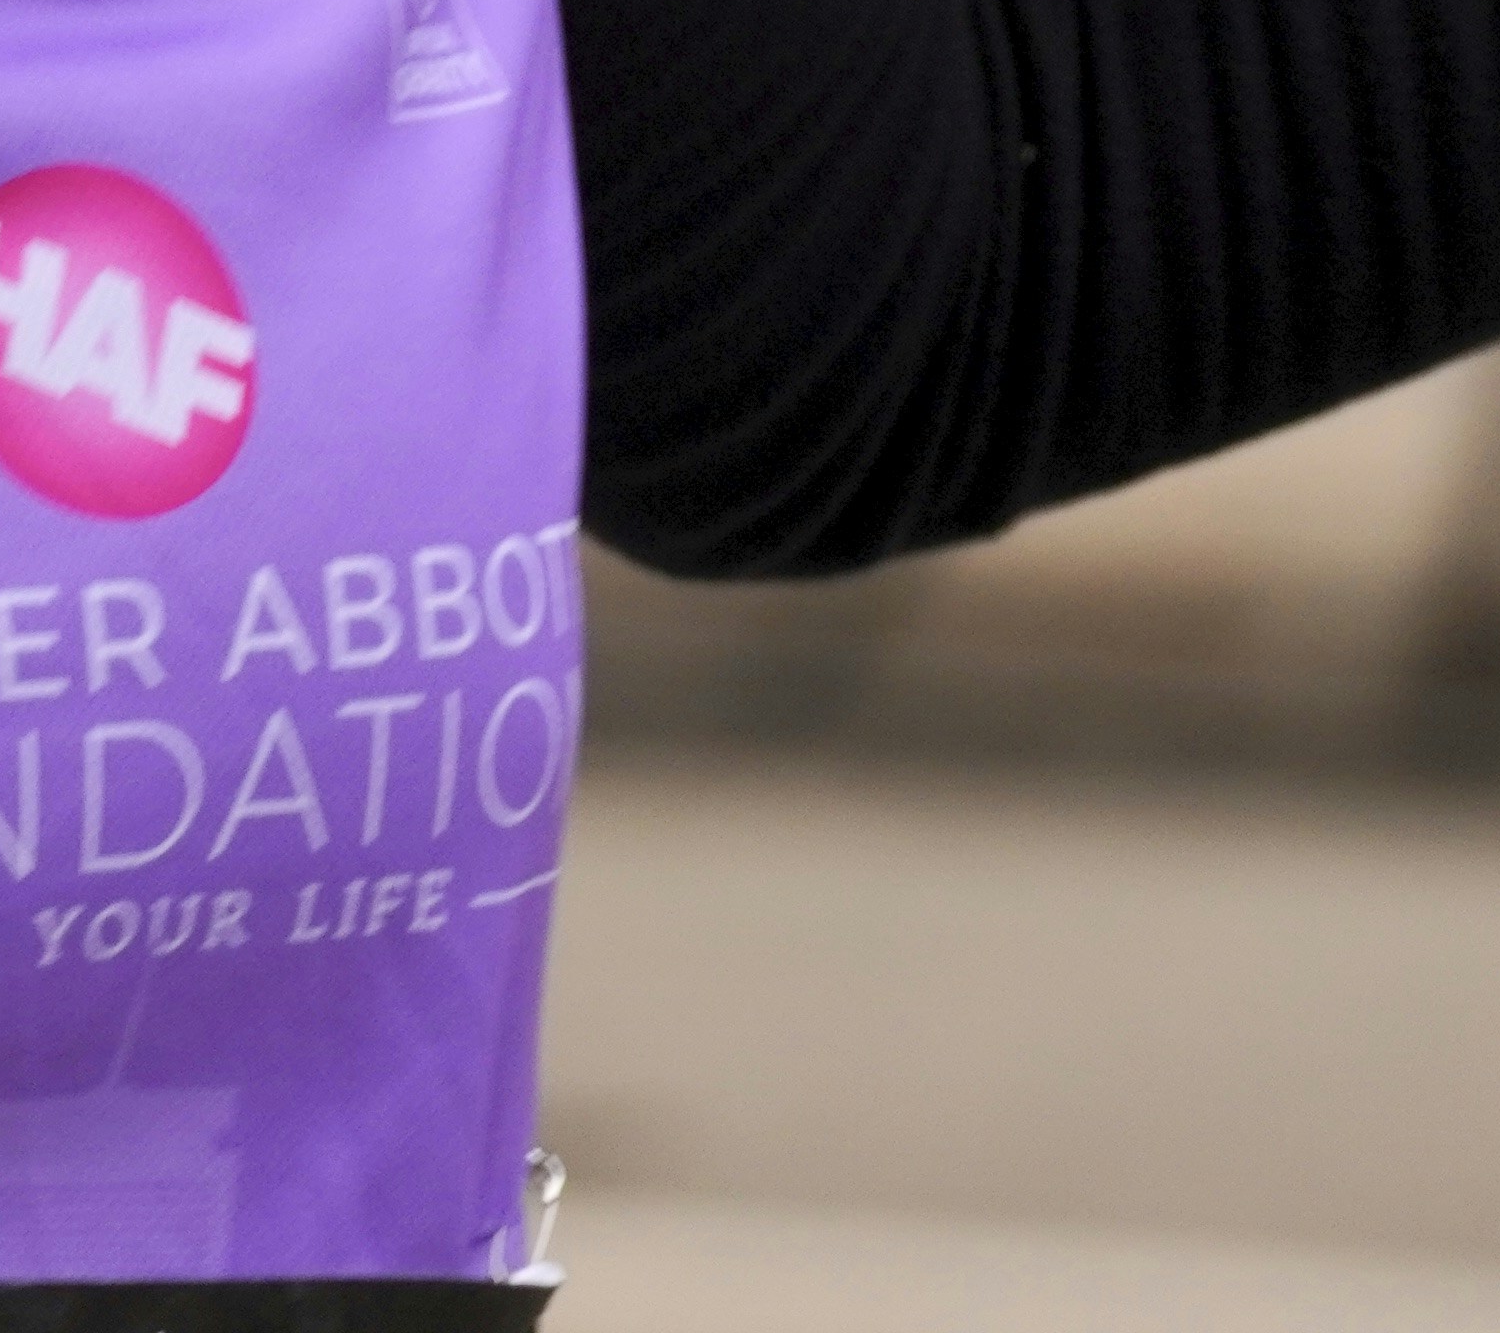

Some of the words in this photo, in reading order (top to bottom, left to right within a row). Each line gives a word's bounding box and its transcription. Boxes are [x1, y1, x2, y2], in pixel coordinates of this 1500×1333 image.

[221, 519, 581, 682] ABBOT
[34, 885, 253, 968] YOUR
[287, 869, 455, 945] LIFE
